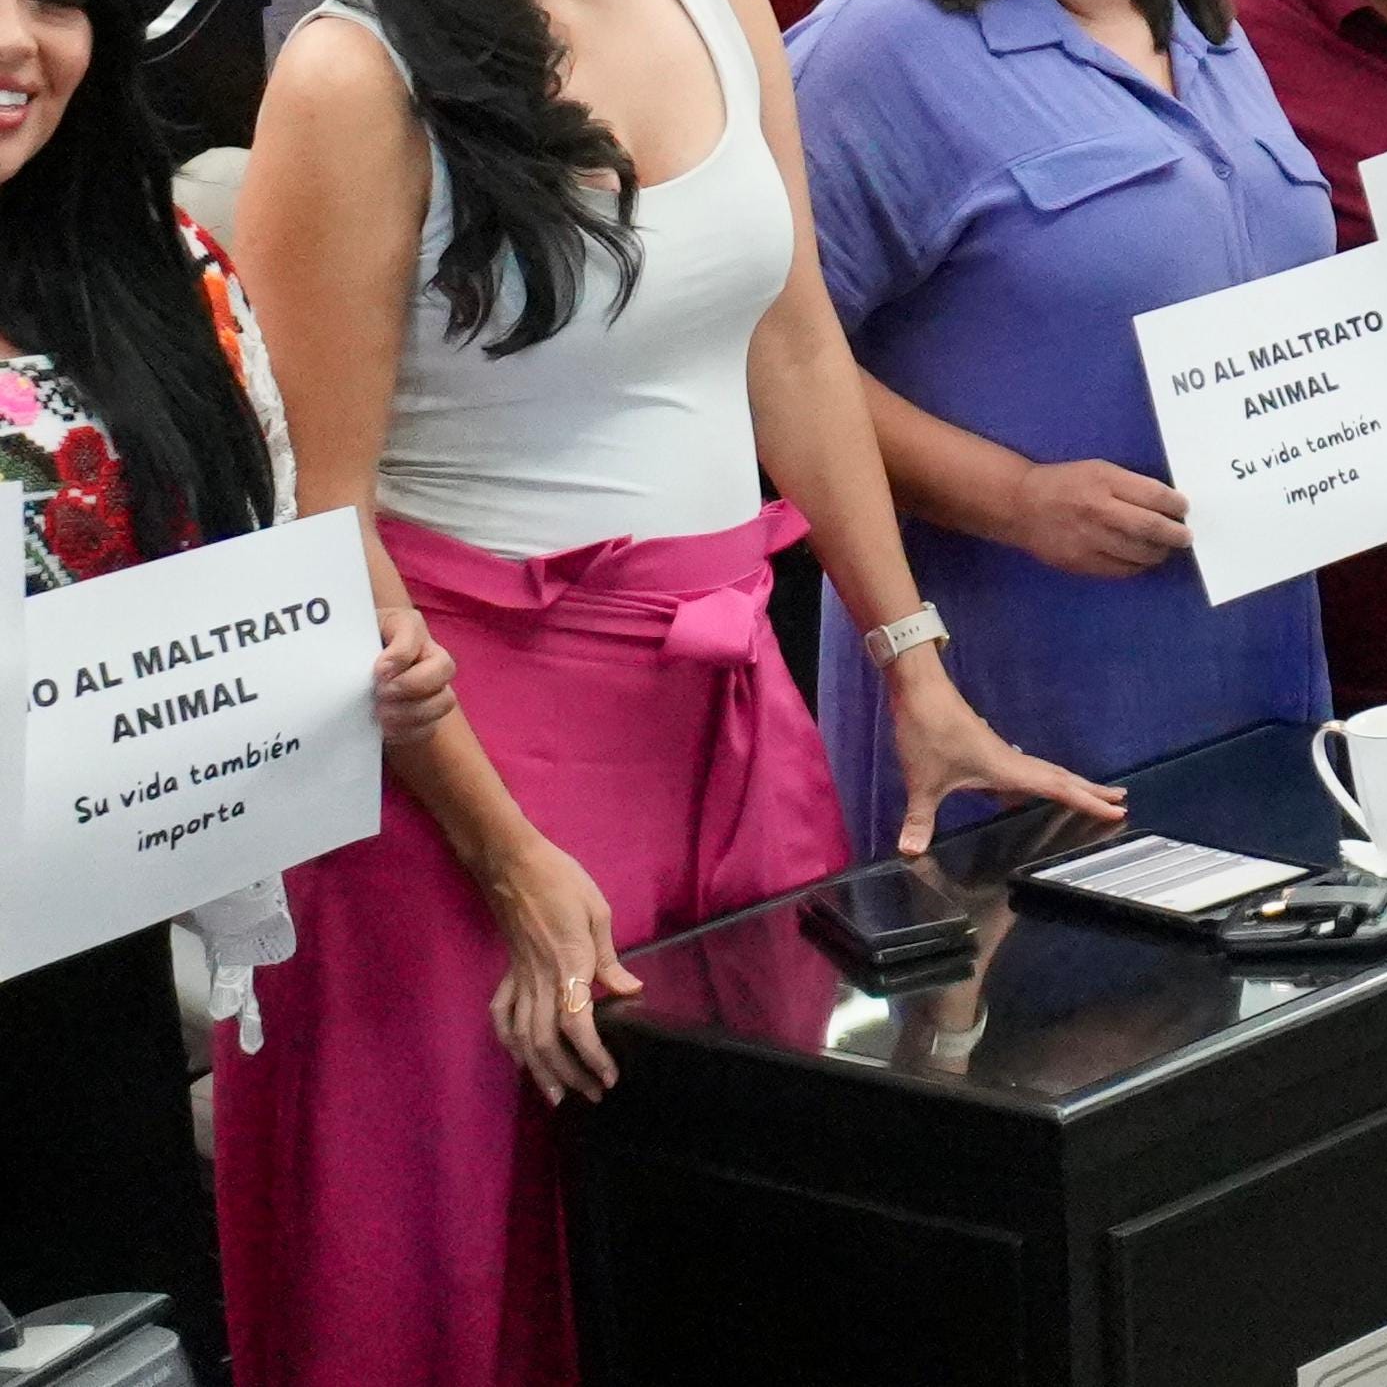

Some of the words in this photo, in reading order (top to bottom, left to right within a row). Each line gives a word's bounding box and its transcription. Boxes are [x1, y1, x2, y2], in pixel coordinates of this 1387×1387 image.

[1172, 368, 1205, 396] NO
[1215, 357, 1245, 384] AL
[1248, 311, 1383, 371] MALTRATO
[1244, 372, 1340, 420] ANIMAL
[1231, 459, 1258, 480] Su
[1261, 442, 1302, 469] vida
[1306, 415, 1381, 453] también
[1284, 469, 1360, 505] importa
[27, 679, 58, 710] O
[76, 662, 123, 697] AL
[132, 598, 330, 679] MALTRATO
[114, 679, 258, 743] ANIMAL
[75, 796, 109, 824] Su
[120, 772, 178, 807] vida
[190, 733, 300, 785] también
[138, 802, 245, 851] importa
